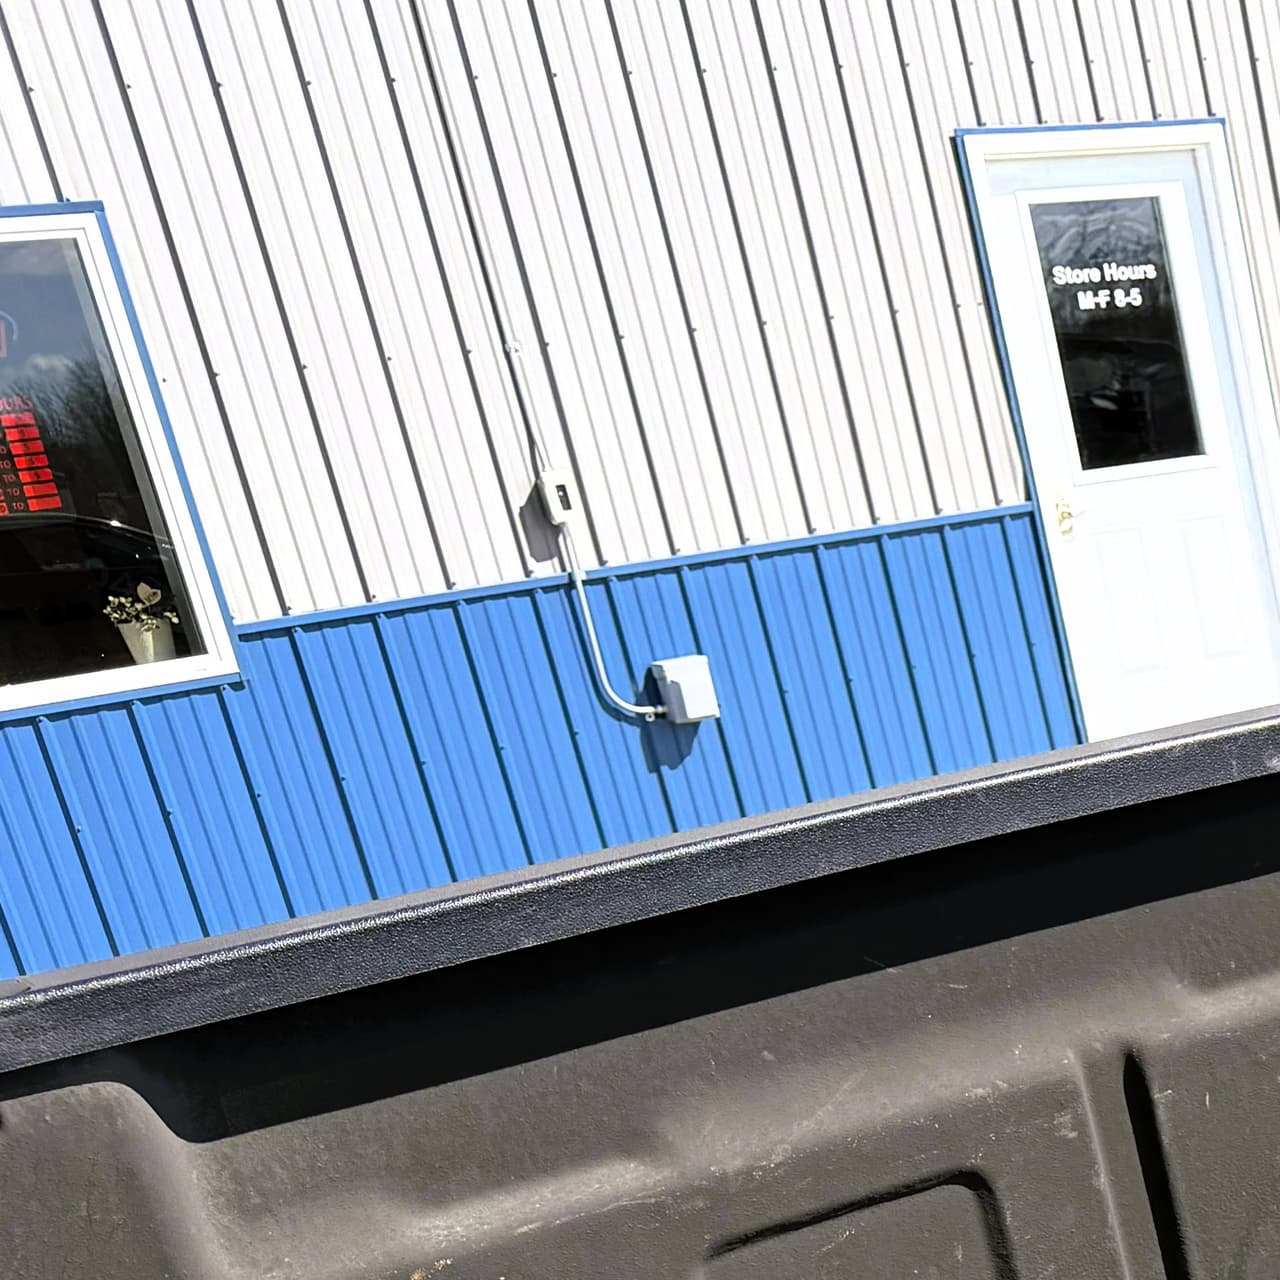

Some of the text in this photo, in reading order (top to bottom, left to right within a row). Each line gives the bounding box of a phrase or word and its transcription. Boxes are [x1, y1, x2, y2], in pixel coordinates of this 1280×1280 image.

[1052, 262, 1157, 285] Store Hours
[1077, 288, 1142, 310] M-F 8-5
